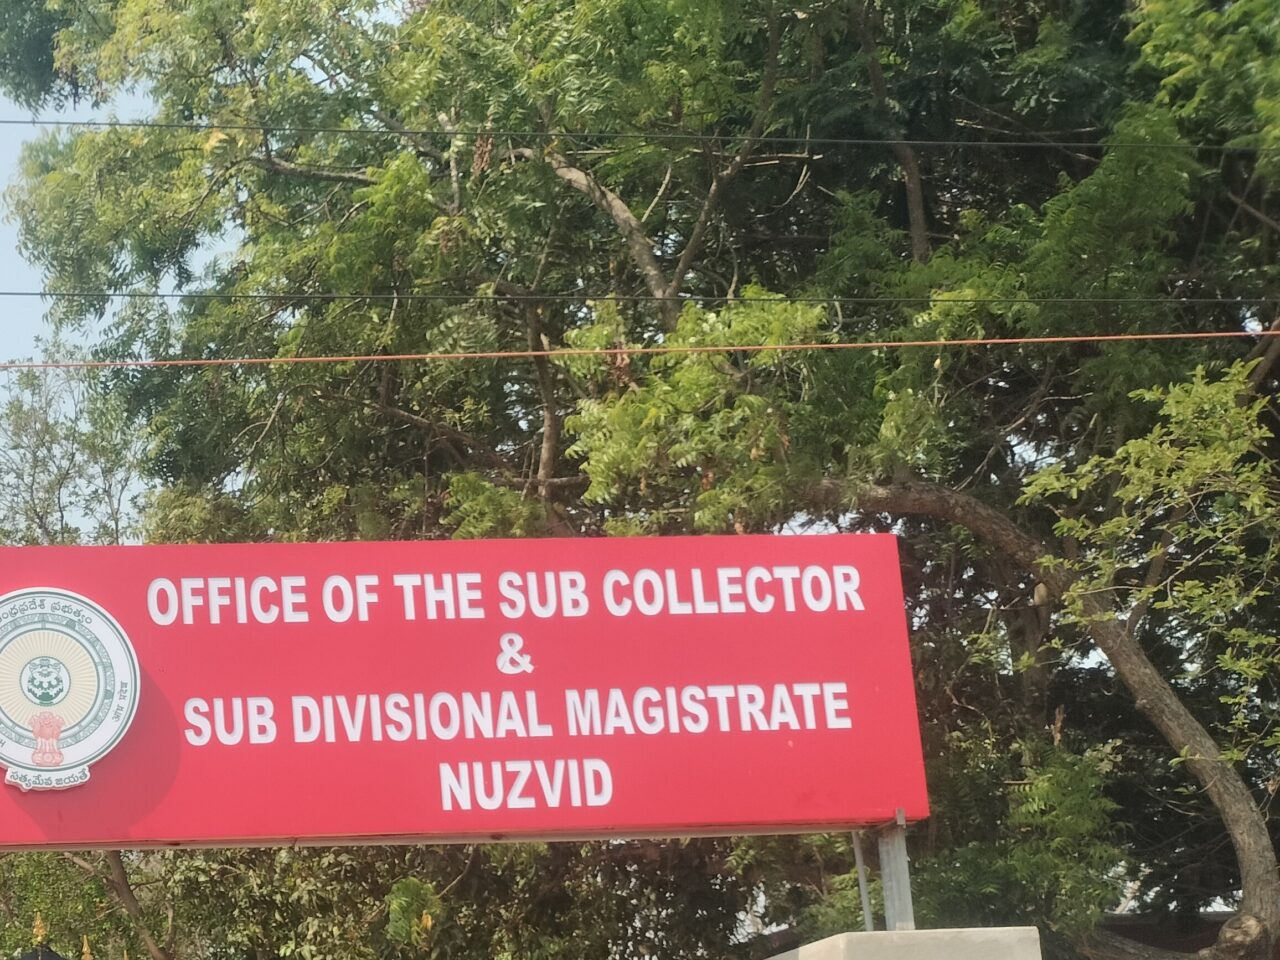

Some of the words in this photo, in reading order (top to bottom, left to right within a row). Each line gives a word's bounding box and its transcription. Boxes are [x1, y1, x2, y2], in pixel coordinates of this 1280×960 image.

[147, 575, 310, 626] OFFICE
[322, 574, 379, 622] OF
[393, 572, 486, 621] THE
[498, 570, 590, 619] SUB
[602, 564, 866, 617] COLLECTOR
[496, 633, 535, 675] &
[184, 696, 277, 747] SUB
[291, 690, 554, 743] DIVISIONAL
[565, 682, 853, 737] MAGISTRATE
[439, 758, 613, 811] NUZVID
